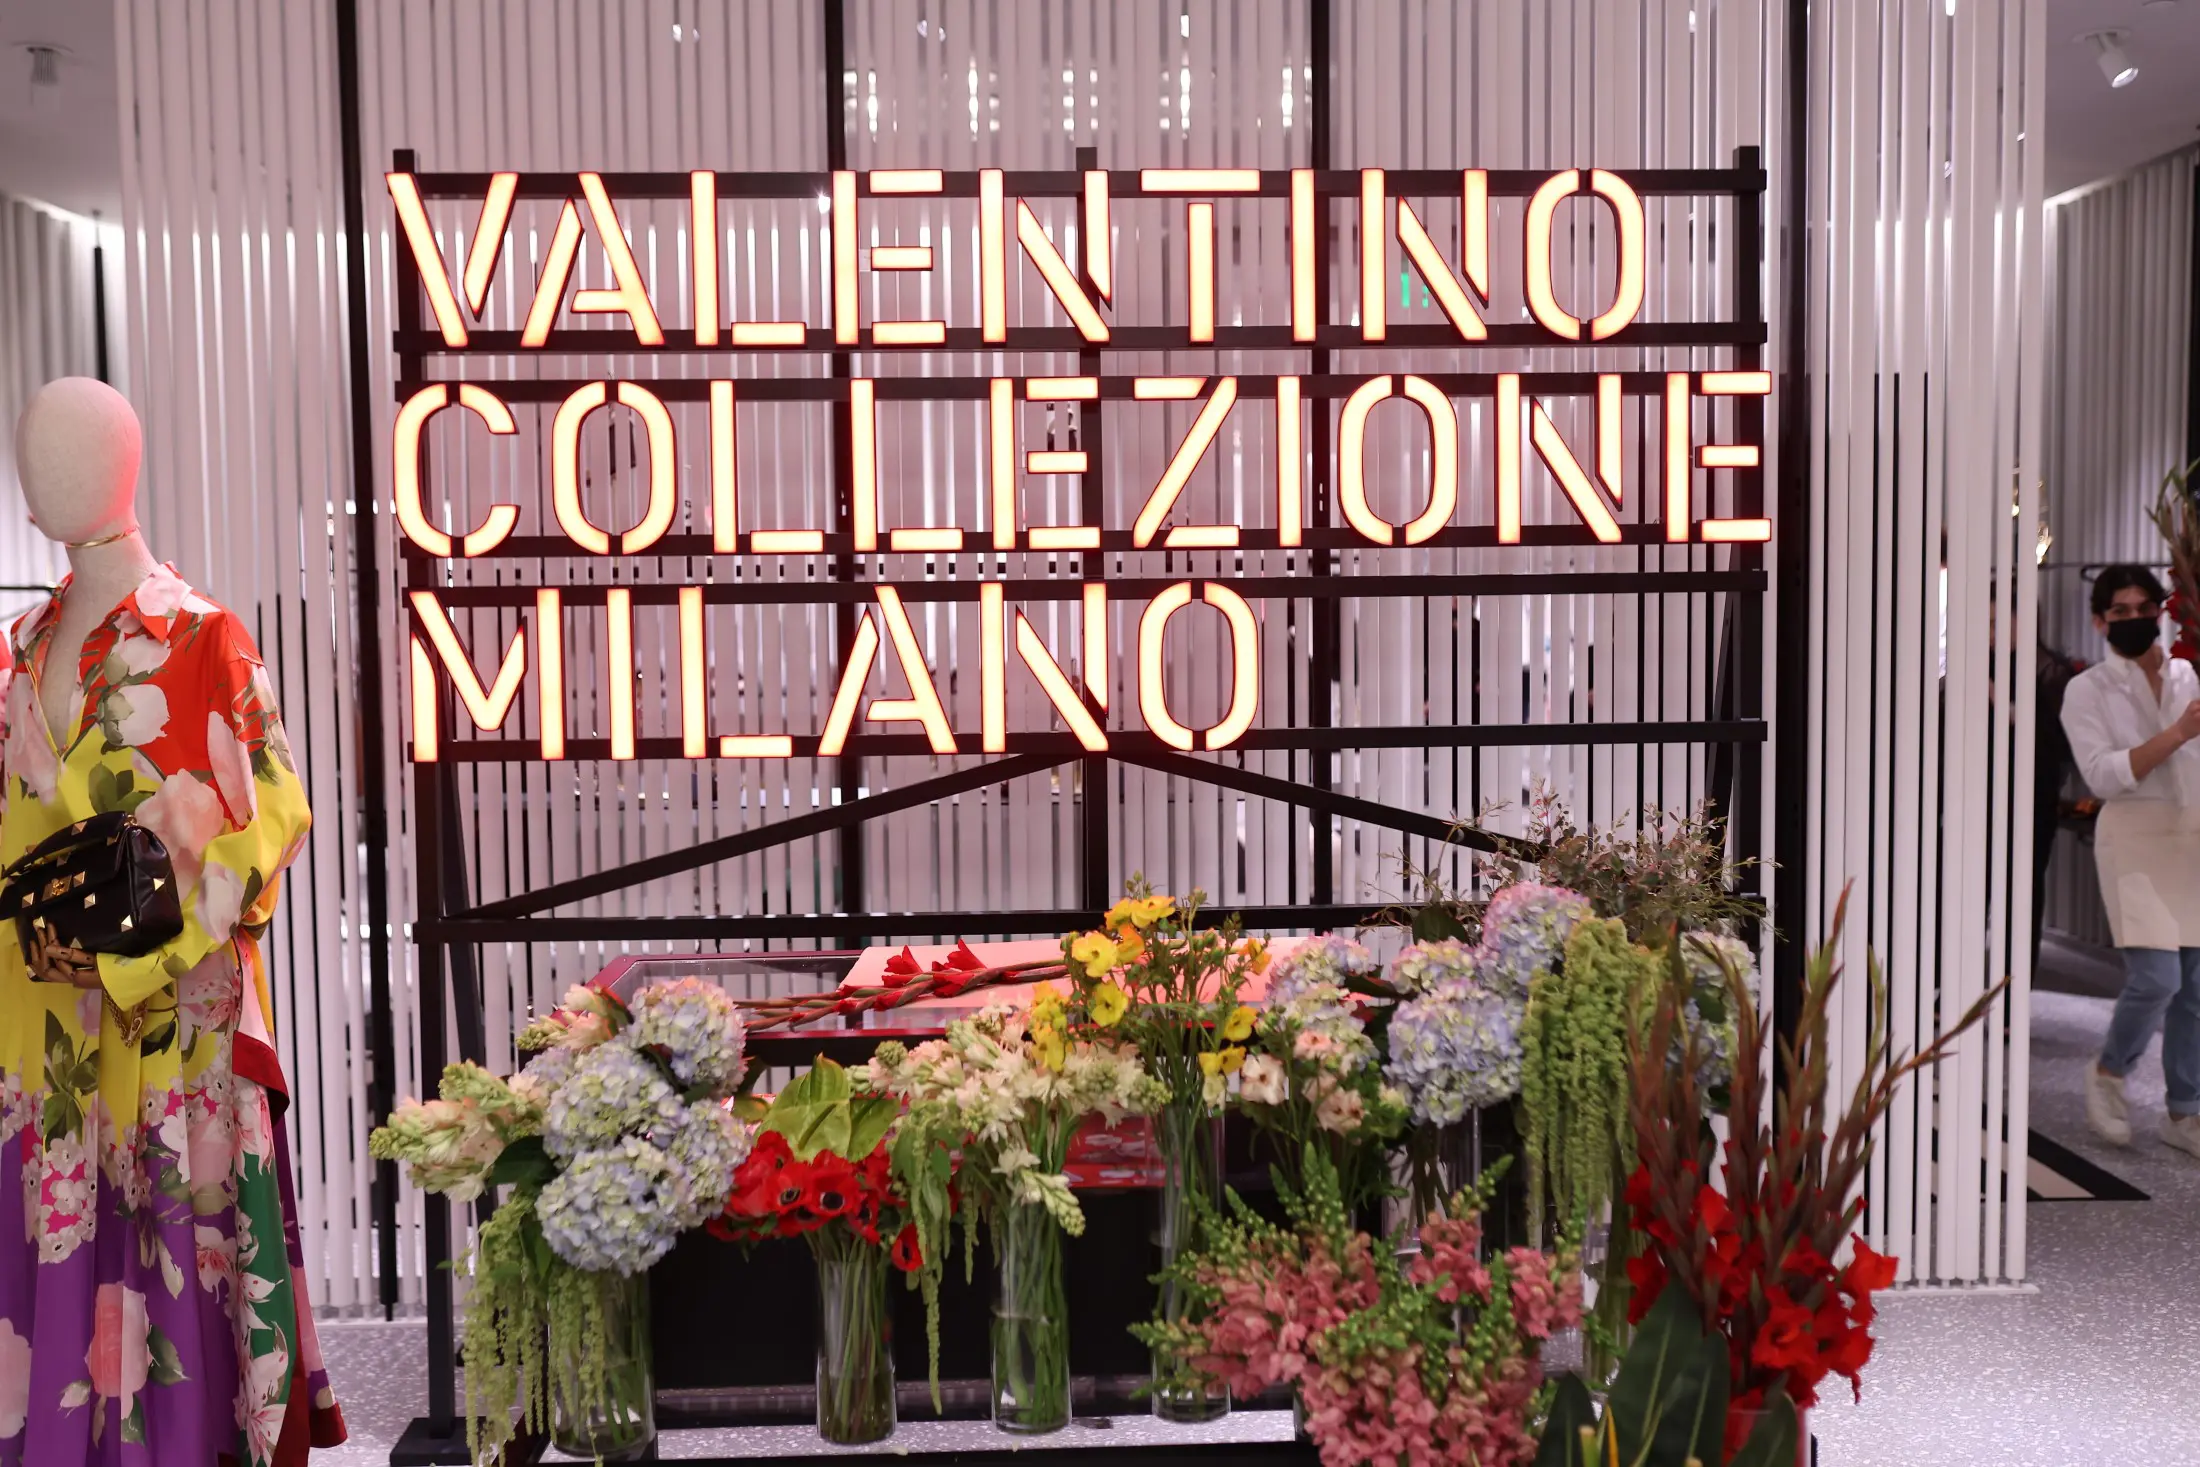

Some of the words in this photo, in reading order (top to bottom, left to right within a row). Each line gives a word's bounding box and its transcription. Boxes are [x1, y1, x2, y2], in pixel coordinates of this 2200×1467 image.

[387, 168, 1646, 347] VALENTINO
[393, 371, 1772, 558] COLLEZIONE
[409, 581, 1258, 764] MILANO
